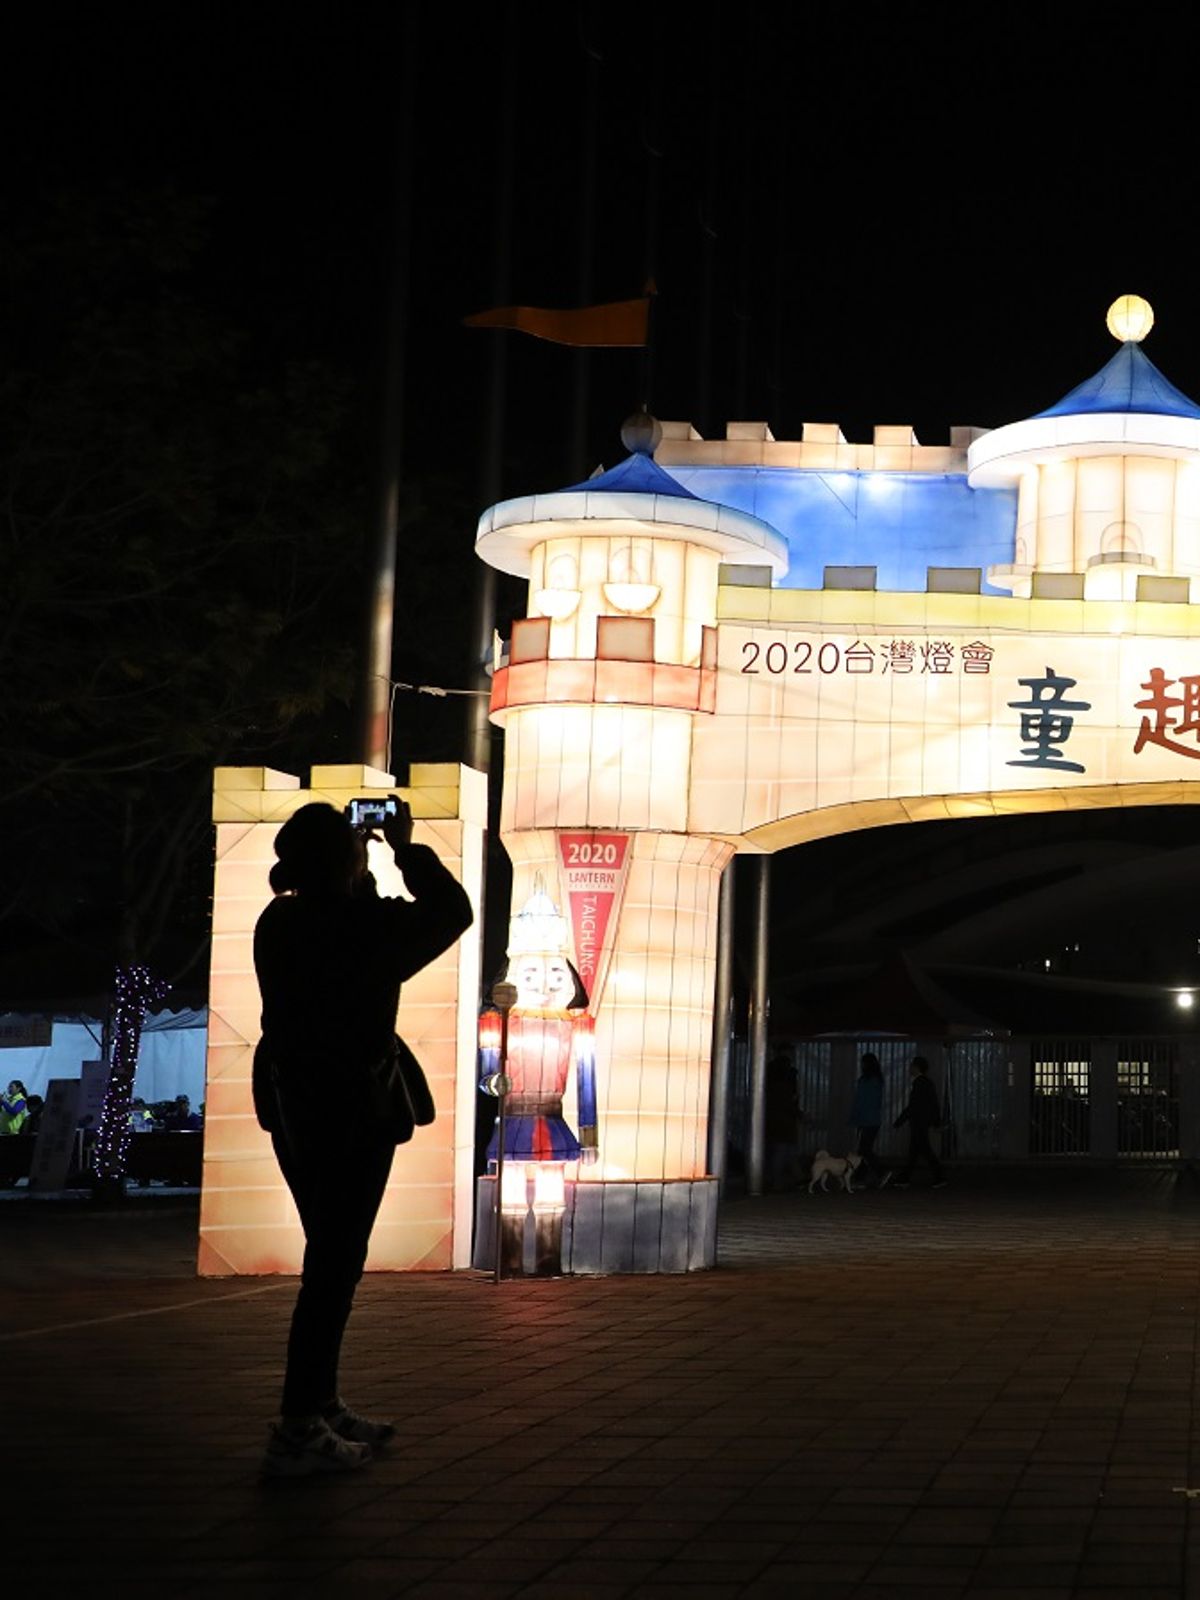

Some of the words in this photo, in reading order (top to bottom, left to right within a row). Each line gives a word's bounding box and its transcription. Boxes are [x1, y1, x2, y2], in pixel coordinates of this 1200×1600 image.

[740, 640, 996, 675] 2020台灣燈會
[568, 843, 616, 864] 2020
[569, 872, 615, 883] LANTERN
[580, 895, 597, 976] TAICHUNG
